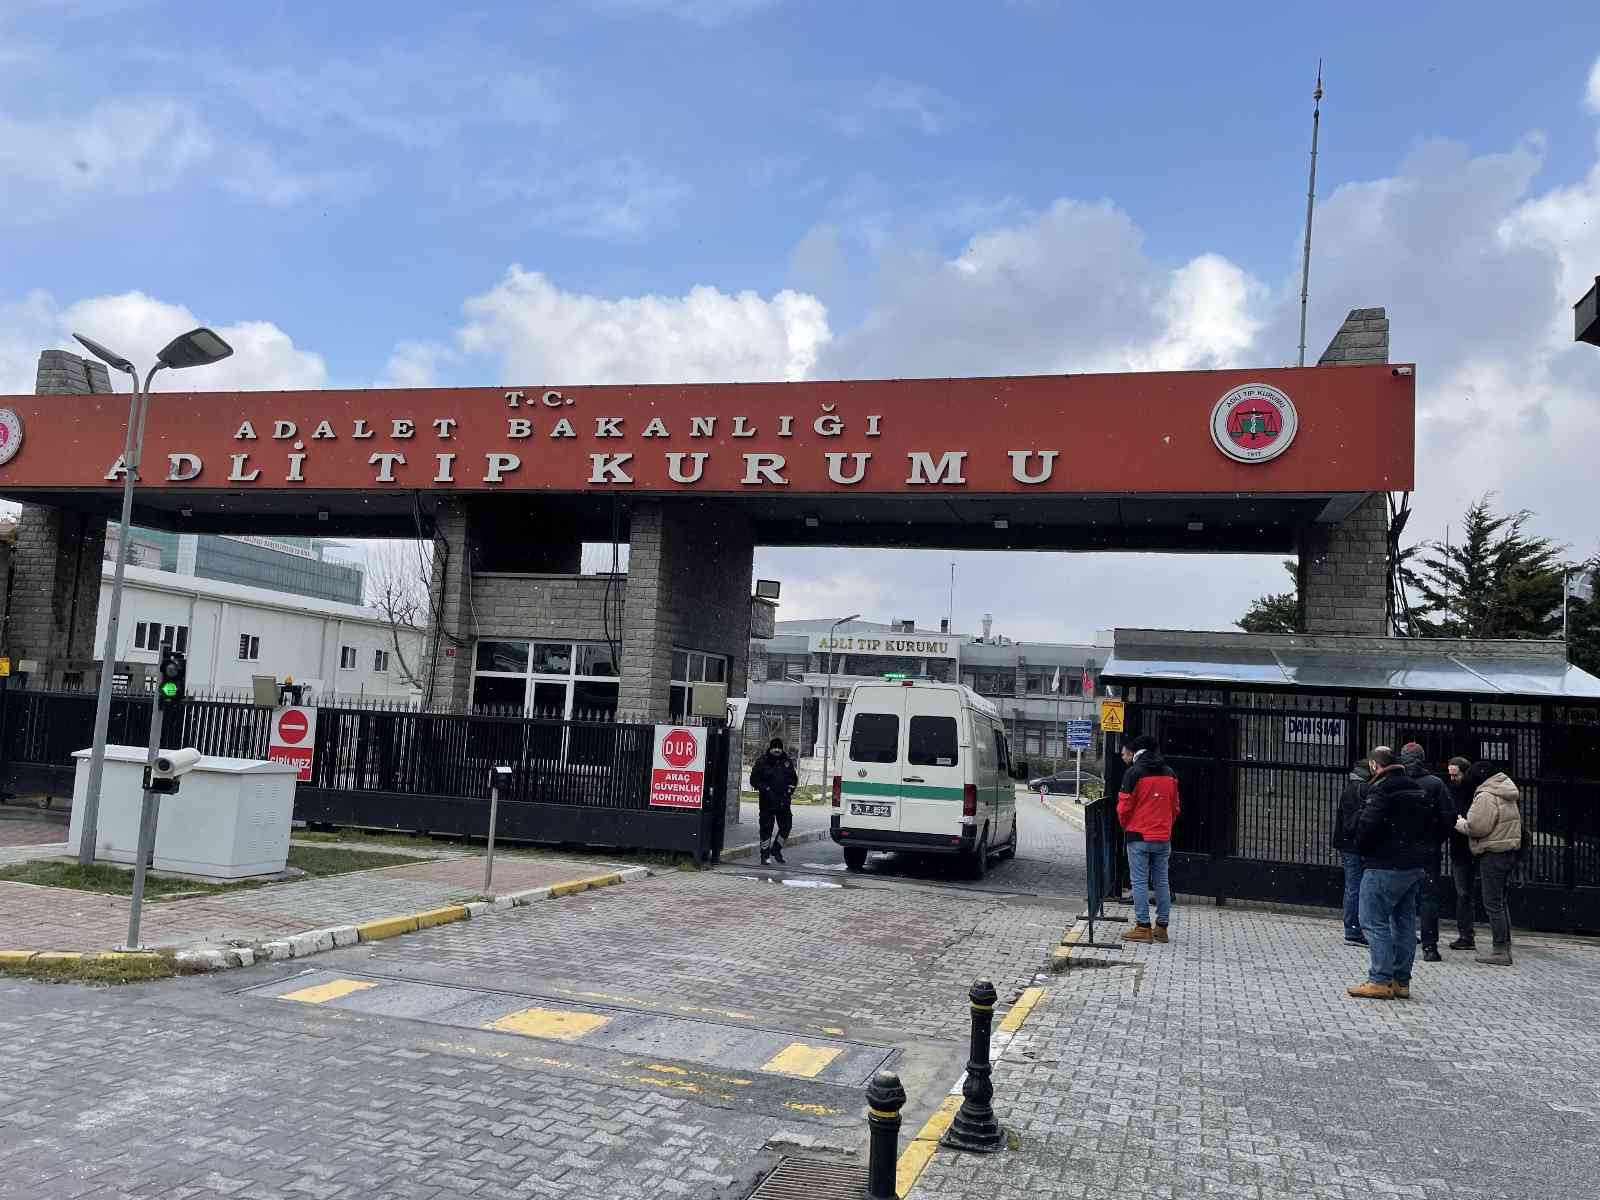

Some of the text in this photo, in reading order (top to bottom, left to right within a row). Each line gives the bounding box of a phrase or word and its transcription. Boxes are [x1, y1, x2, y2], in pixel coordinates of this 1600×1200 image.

[505, 391, 574, 408] T.C.
[234, 402, 882, 439] ADALET BAKANLIĞI
[104, 440, 1059, 484] ADLİ TIP KURUMU
[857, 638, 881, 651] TIP
[885, 640, 948, 653] KURUMU
[665, 741, 694, 757] DUR
[665, 773, 690, 784] ARAÇ
